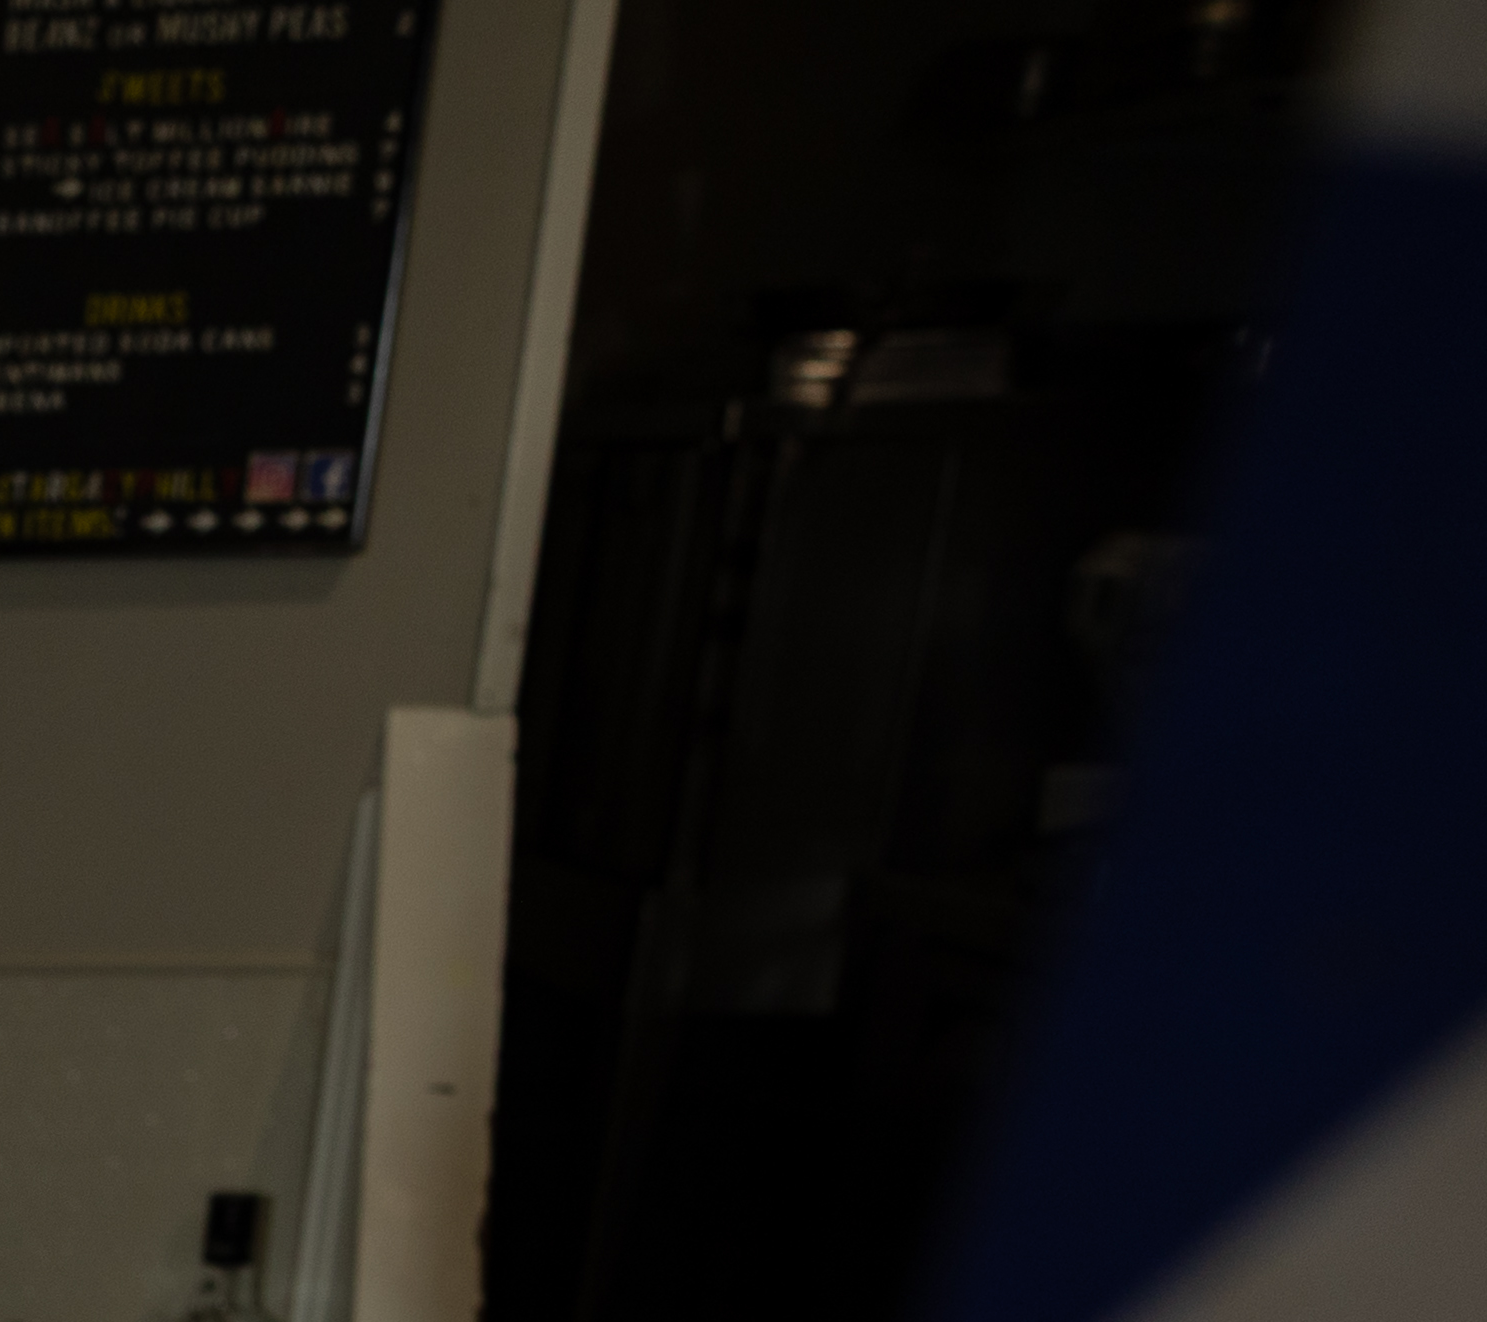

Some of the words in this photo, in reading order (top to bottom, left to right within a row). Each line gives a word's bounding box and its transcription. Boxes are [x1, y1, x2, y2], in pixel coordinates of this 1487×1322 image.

[155, 8, 263, 45] MUSHY
[268, 6, 348, 42] PEAS
[98, 68, 226, 106] SWEETS
[83, 291, 190, 326] DRINKS
